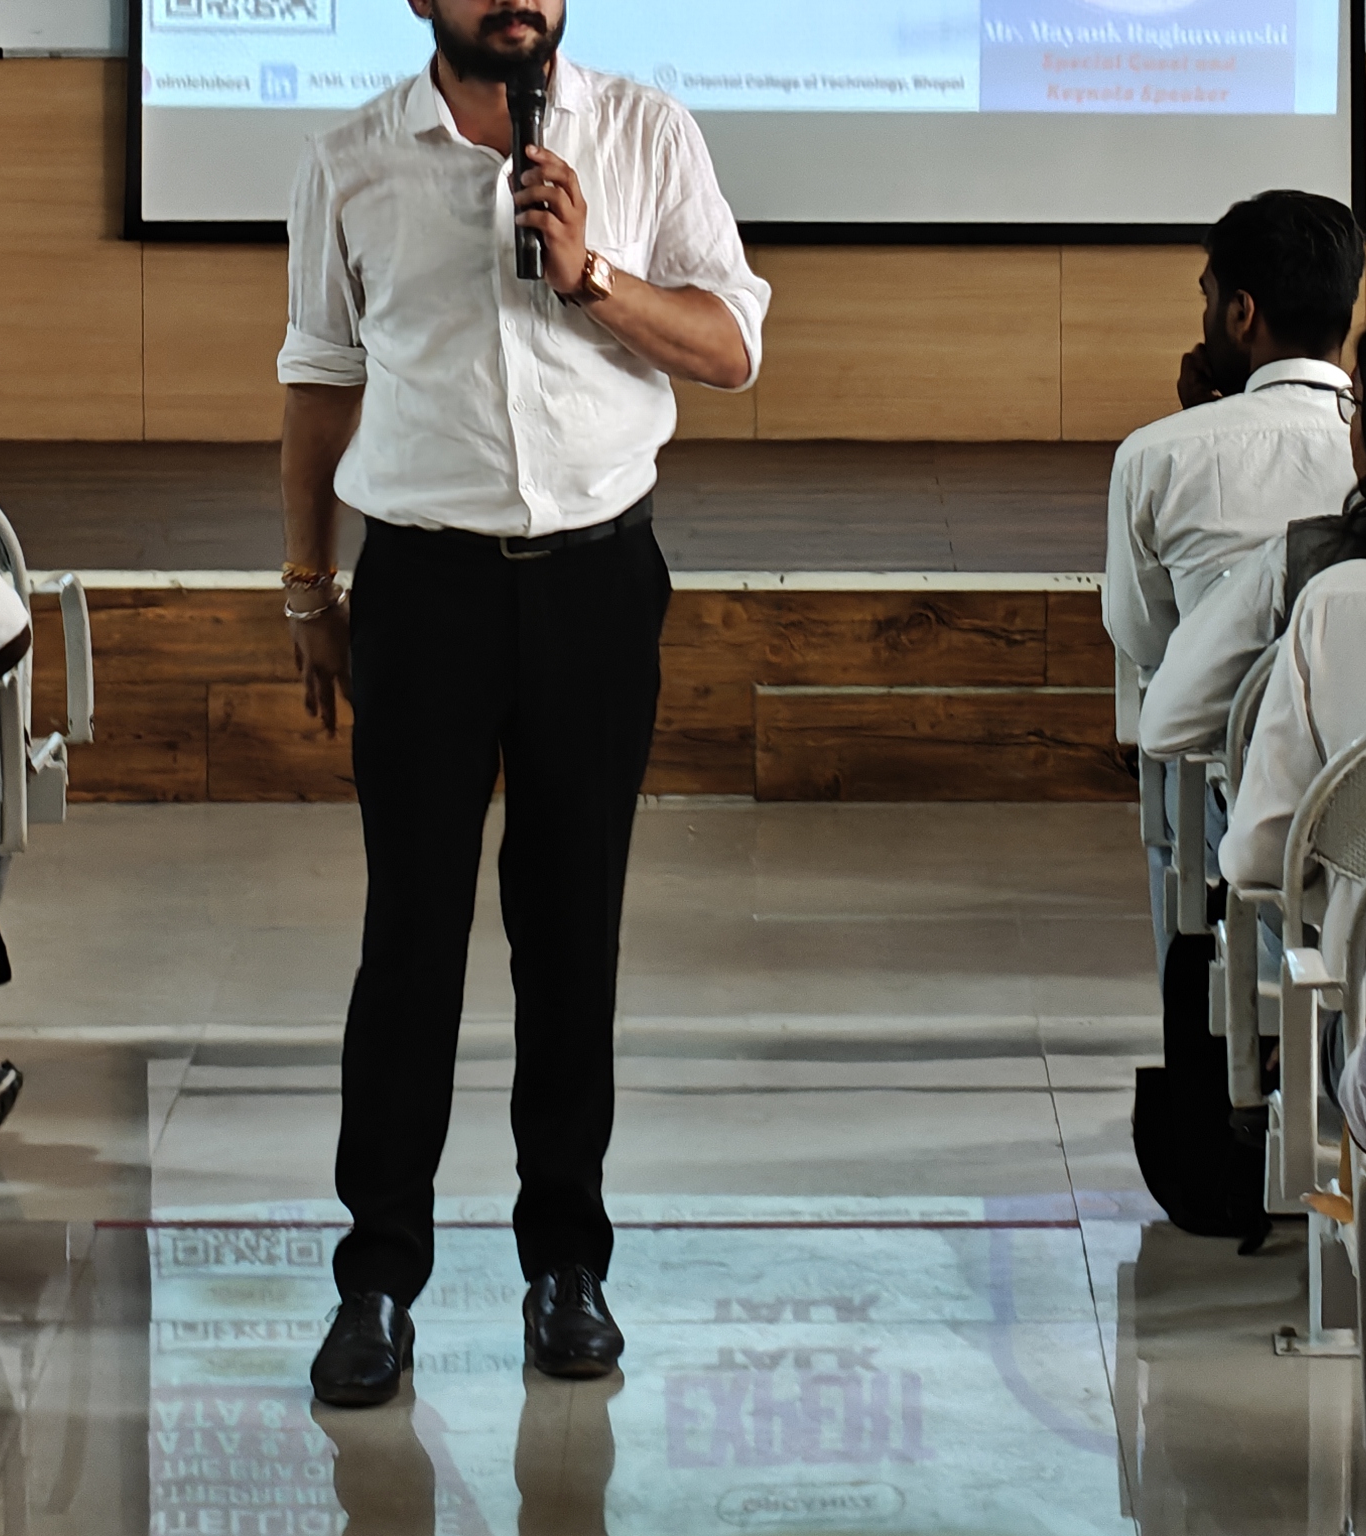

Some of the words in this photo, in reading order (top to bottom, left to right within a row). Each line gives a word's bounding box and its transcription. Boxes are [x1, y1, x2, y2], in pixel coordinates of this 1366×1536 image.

[1031, 20, 1122, 47] Mayank
[1128, 22, 1288, 49] Raghuwanshi
[1042, 52, 1122, 73] Special
[1128, 53, 1188, 73] Guest
[683, 72, 742, 91] Oriental
[746, 73, 801, 94] College
[913, 74, 965, 95] Bhopal
[1046, 84, 1134, 103] Keynote
[1140, 85, 1230, 104] Speaker
